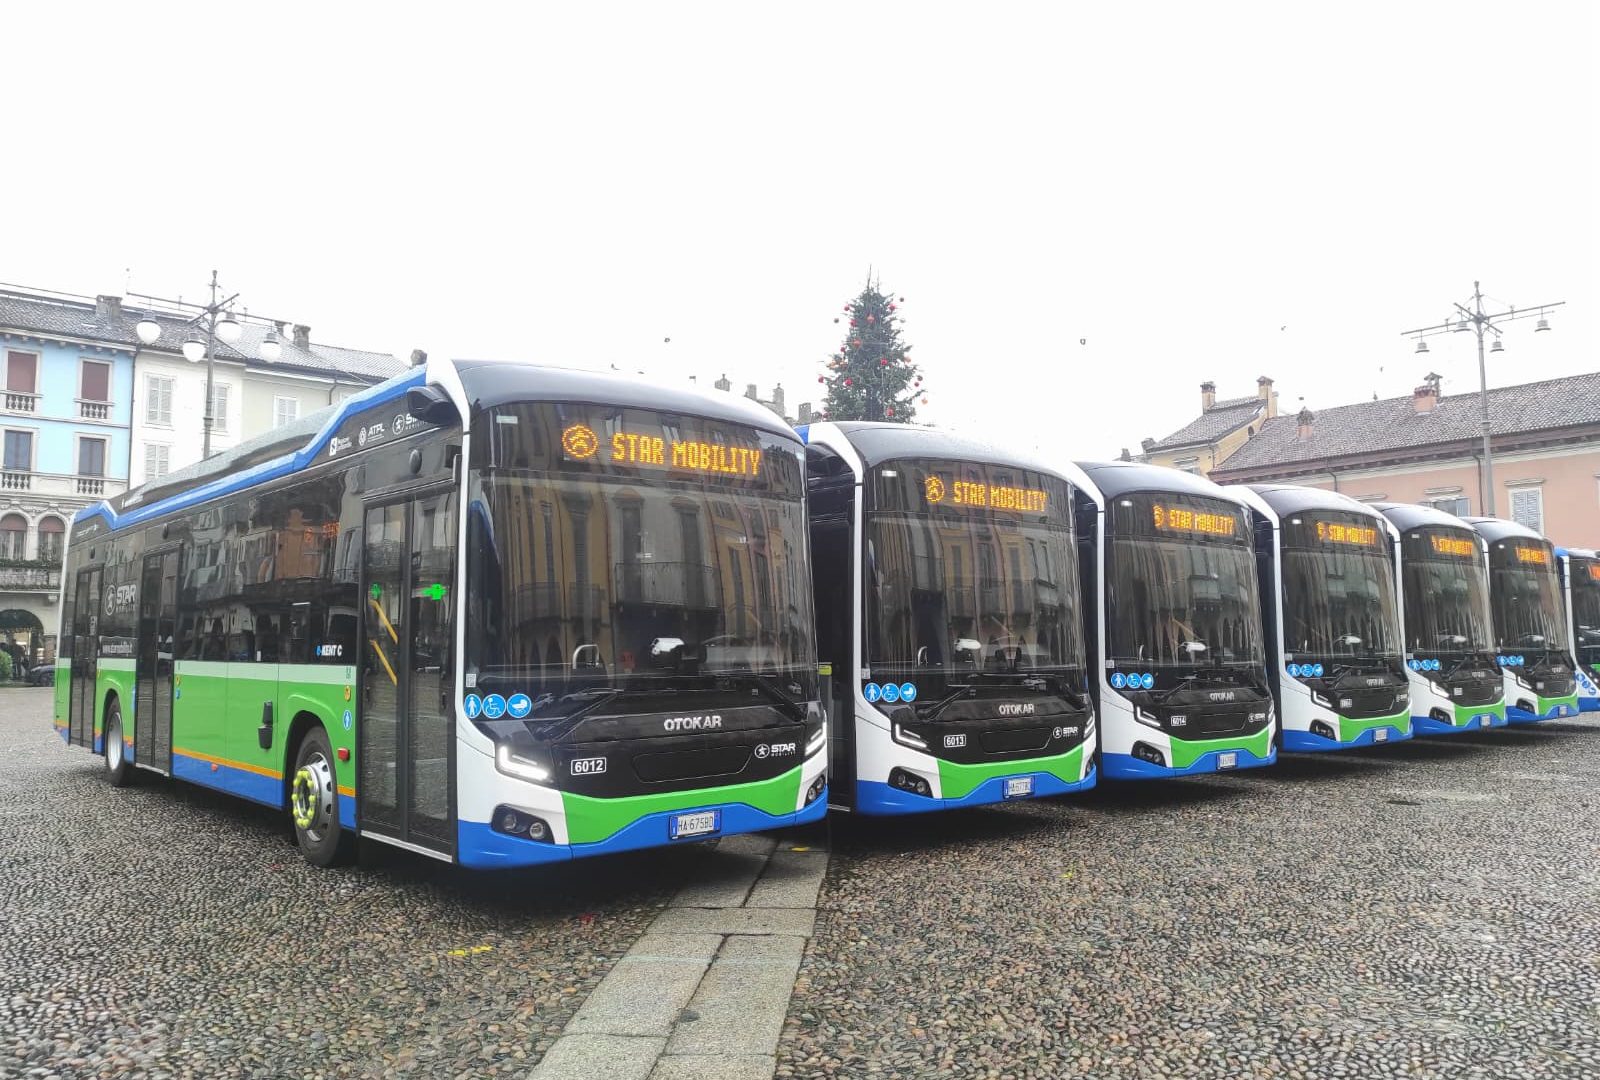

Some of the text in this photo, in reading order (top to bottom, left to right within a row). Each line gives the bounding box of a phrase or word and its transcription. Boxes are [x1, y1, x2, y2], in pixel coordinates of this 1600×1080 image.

[611, 432, 761, 475] STAR MOBILITY
[953, 481, 1047, 512] STAR MOBILITY
[1169, 509, 1234, 535] STAR MOBILITY
[116, 584, 137, 604] STAR
[999, 703, 1035, 715] OTOKAR
[663, 715, 722, 731] OTOKAR
[1062, 726, 1079, 735] STAR
[771, 743, 796, 753] STAR
[946, 736, 965, 746] 6013
[574, 760, 604, 773] 6012
